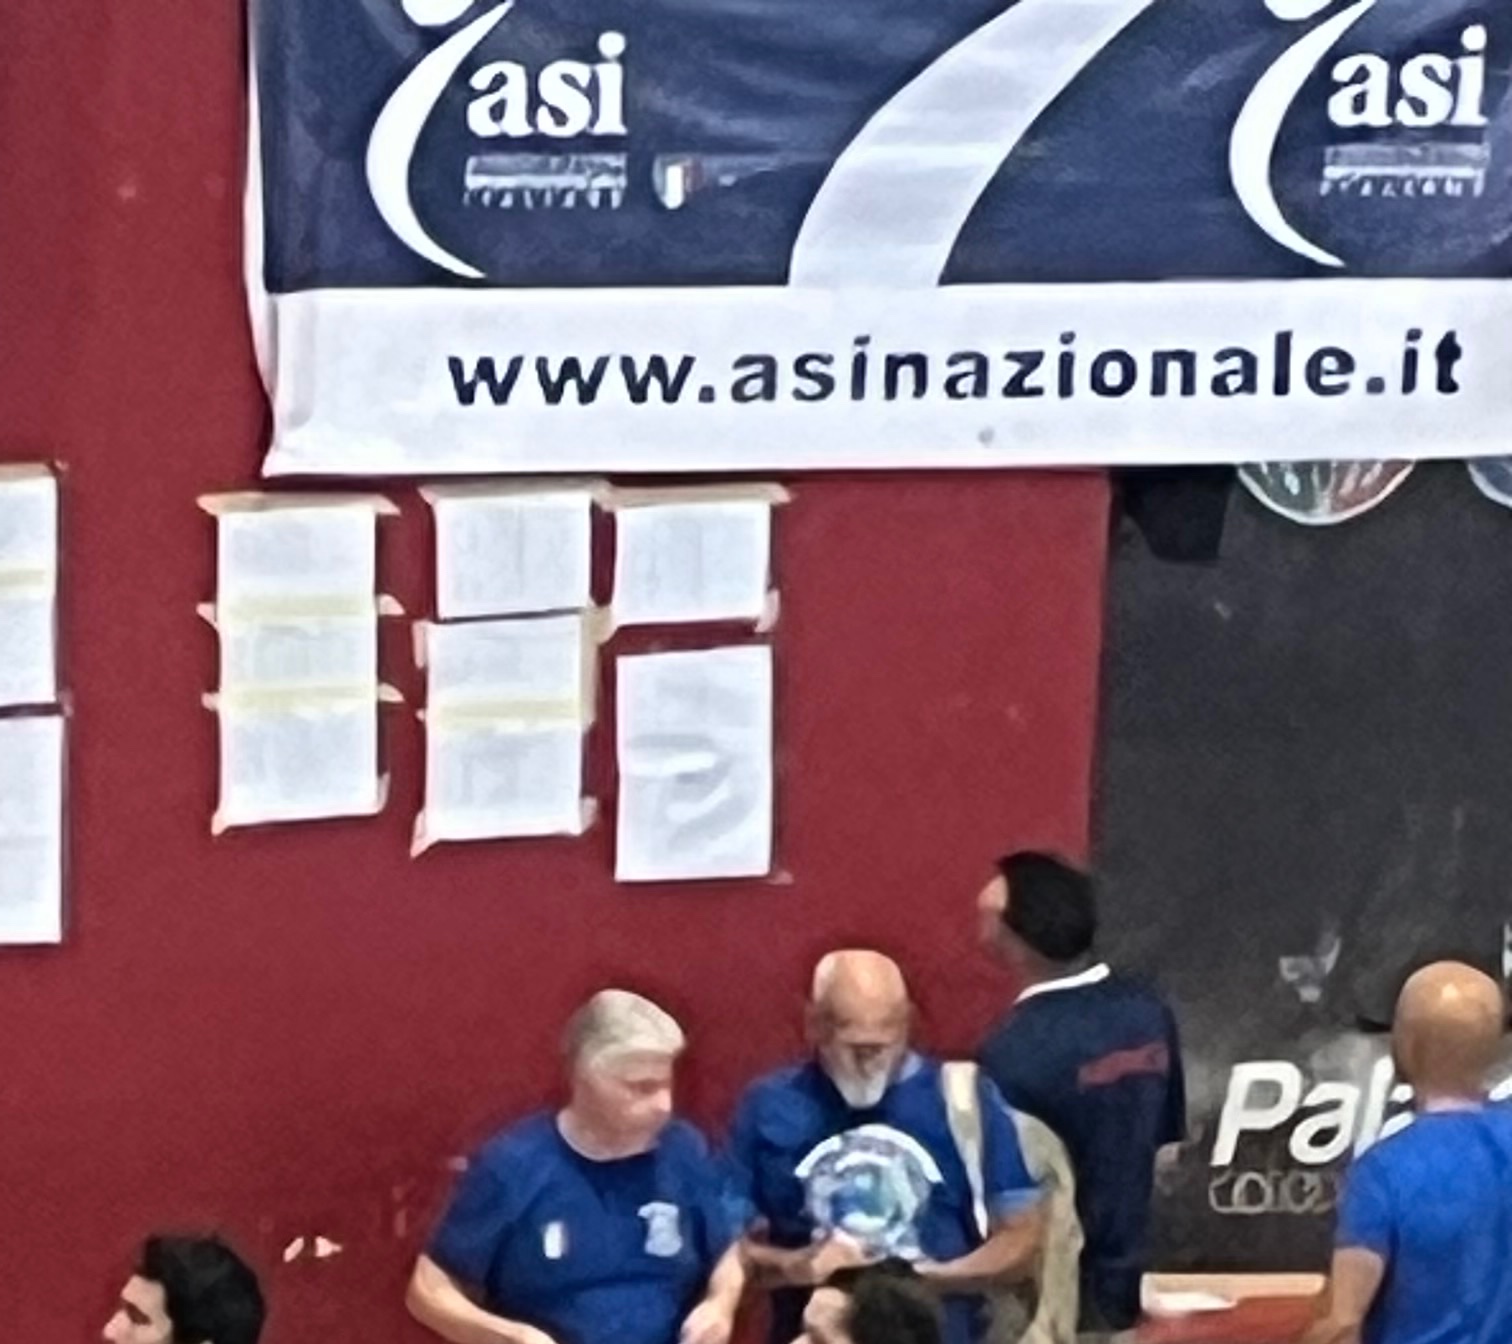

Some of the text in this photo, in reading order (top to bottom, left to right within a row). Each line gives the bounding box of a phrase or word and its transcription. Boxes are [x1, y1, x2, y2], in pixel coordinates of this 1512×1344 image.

[466, 30, 629, 138] asi
[1327, 23, 1488, 127] asi
[445, 326, 1465, 406] www.asinazionale.it
